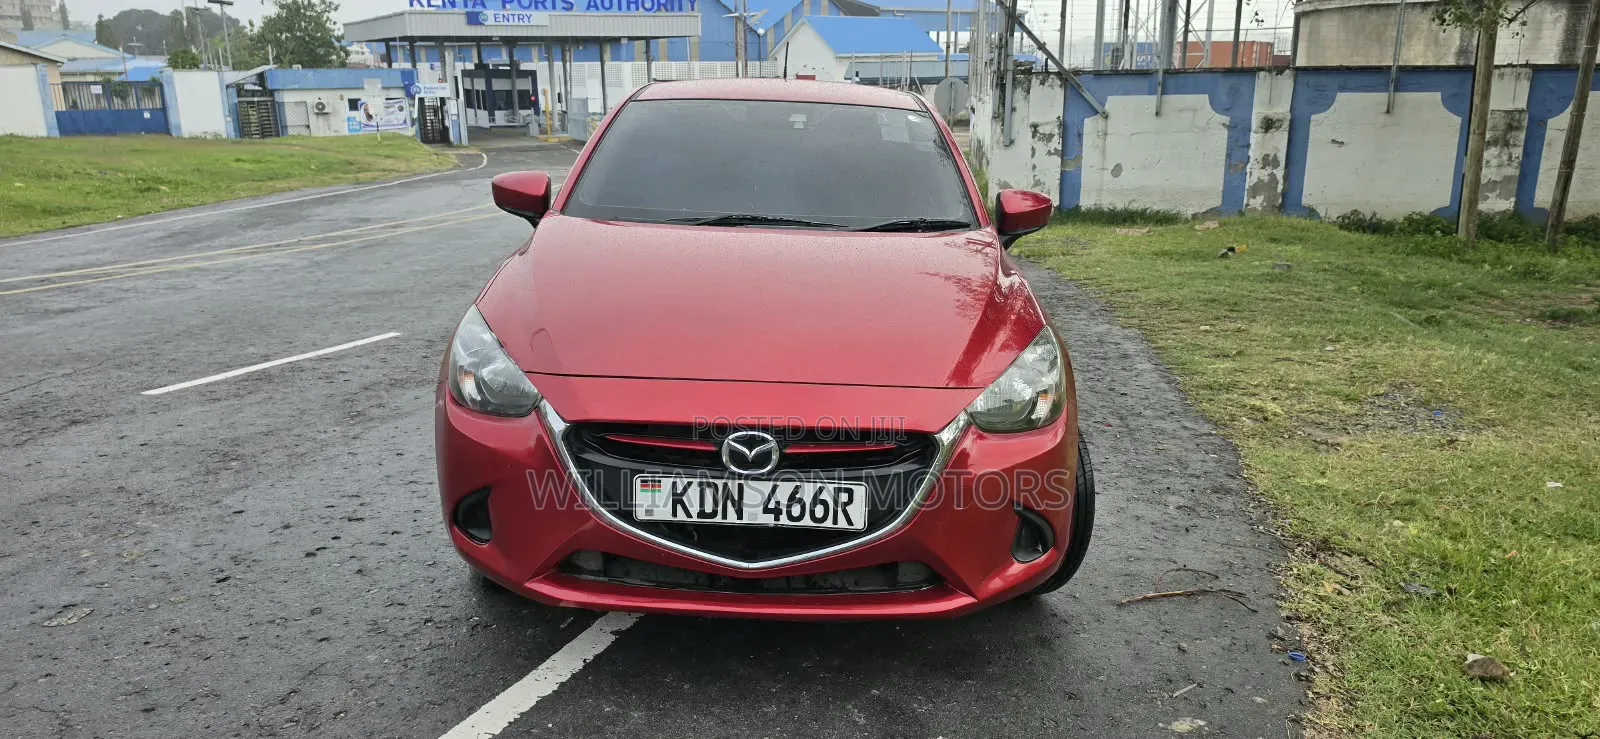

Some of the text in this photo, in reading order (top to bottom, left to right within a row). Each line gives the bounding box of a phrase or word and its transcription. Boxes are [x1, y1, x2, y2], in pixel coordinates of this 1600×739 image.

[501, 0, 575, 11] PORTS
[585, 0, 697, 12] AUTHORITY
[493, 13, 533, 24] ENTRY
[671, 480, 855, 527] KDN 466R
